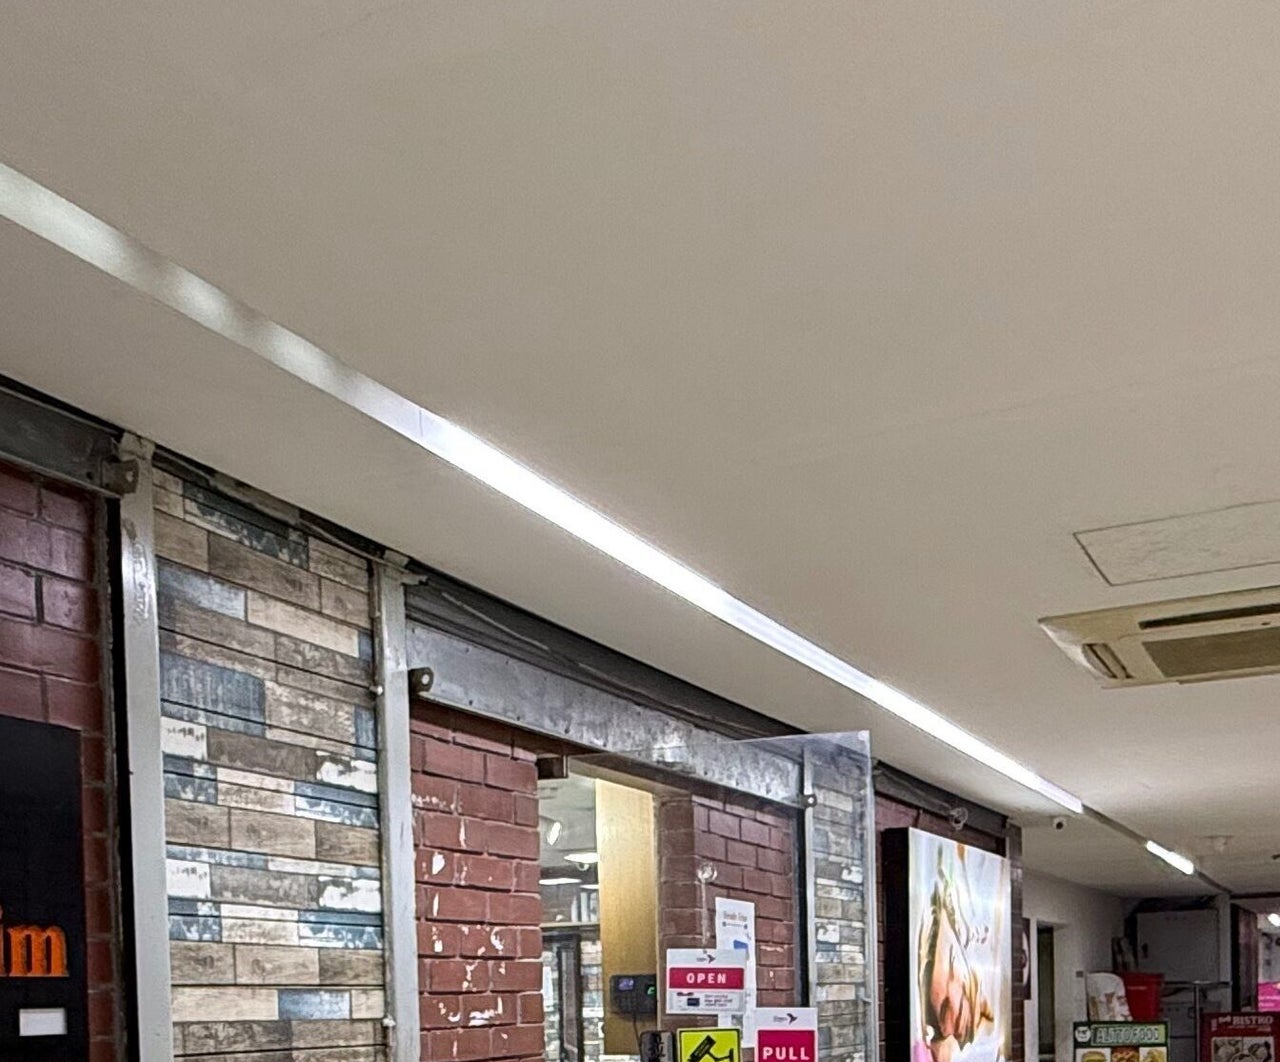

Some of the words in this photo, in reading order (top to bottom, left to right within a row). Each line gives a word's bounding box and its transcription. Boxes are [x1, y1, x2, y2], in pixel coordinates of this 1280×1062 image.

[686, 972, 727, 985] OPEN
[1231, 1015, 1274, 1026] BISTRO
[762, 1046, 810, 1061] PULL
